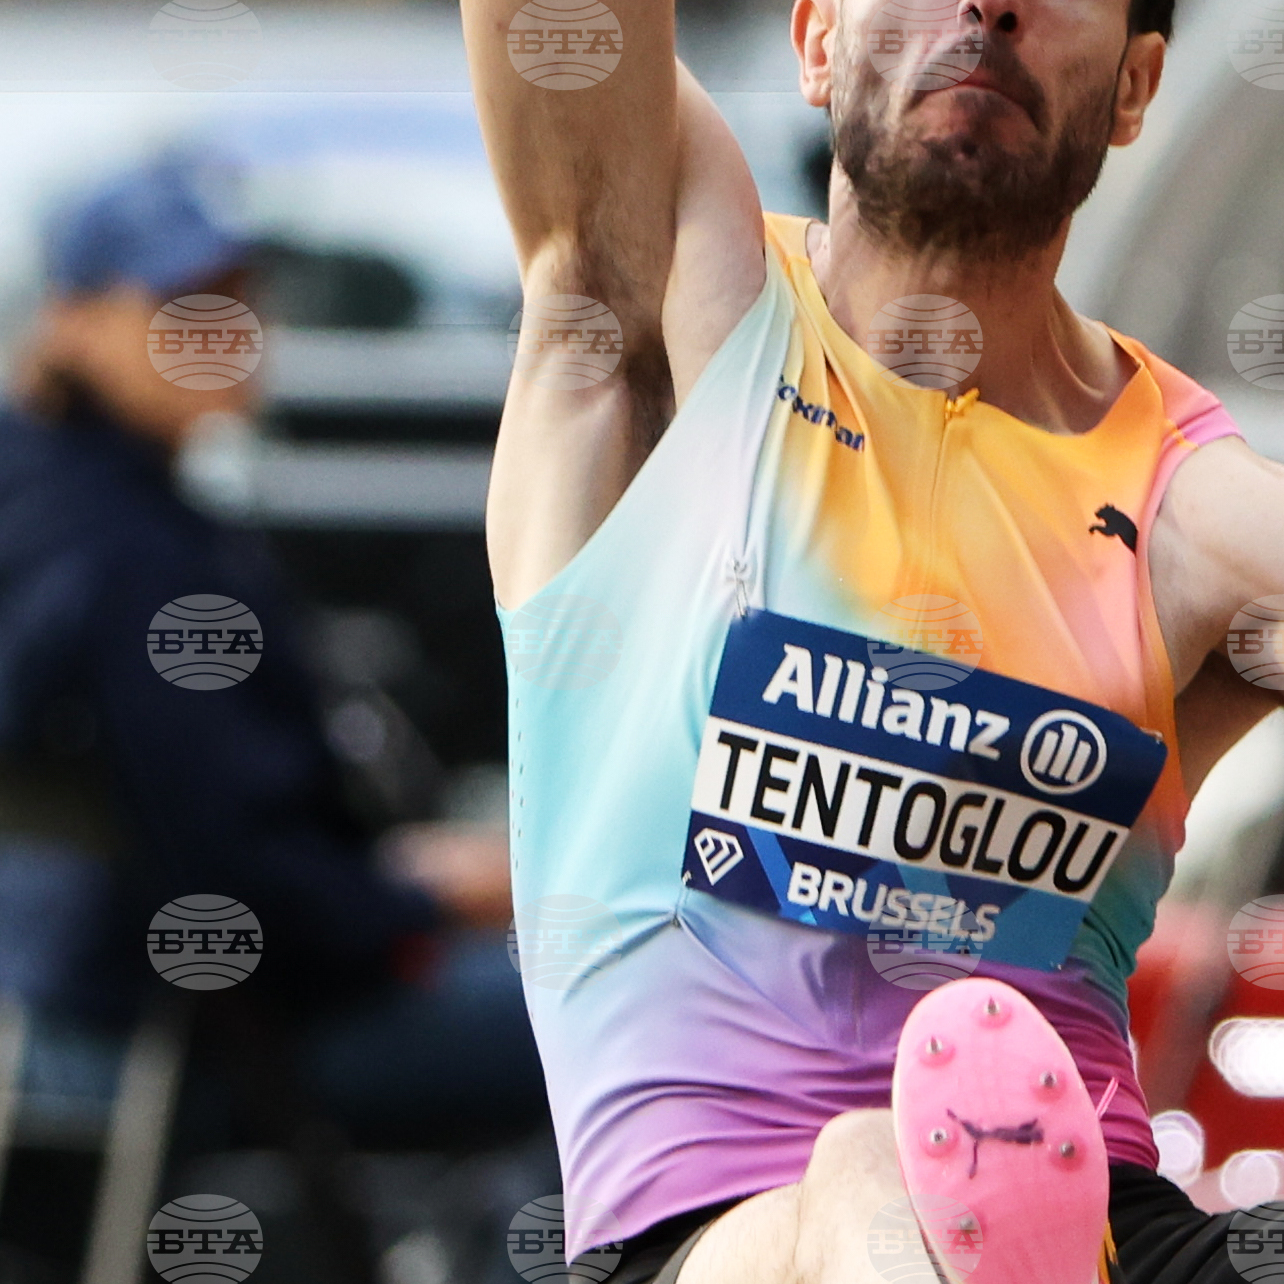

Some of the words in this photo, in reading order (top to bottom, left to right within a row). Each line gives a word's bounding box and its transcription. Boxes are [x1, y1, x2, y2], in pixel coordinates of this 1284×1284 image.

[762, 643, 1011, 761] Allianz
[717, 731, 1118, 893] TENTOGLOU
[787, 862, 1001, 943] BRUSSELS
